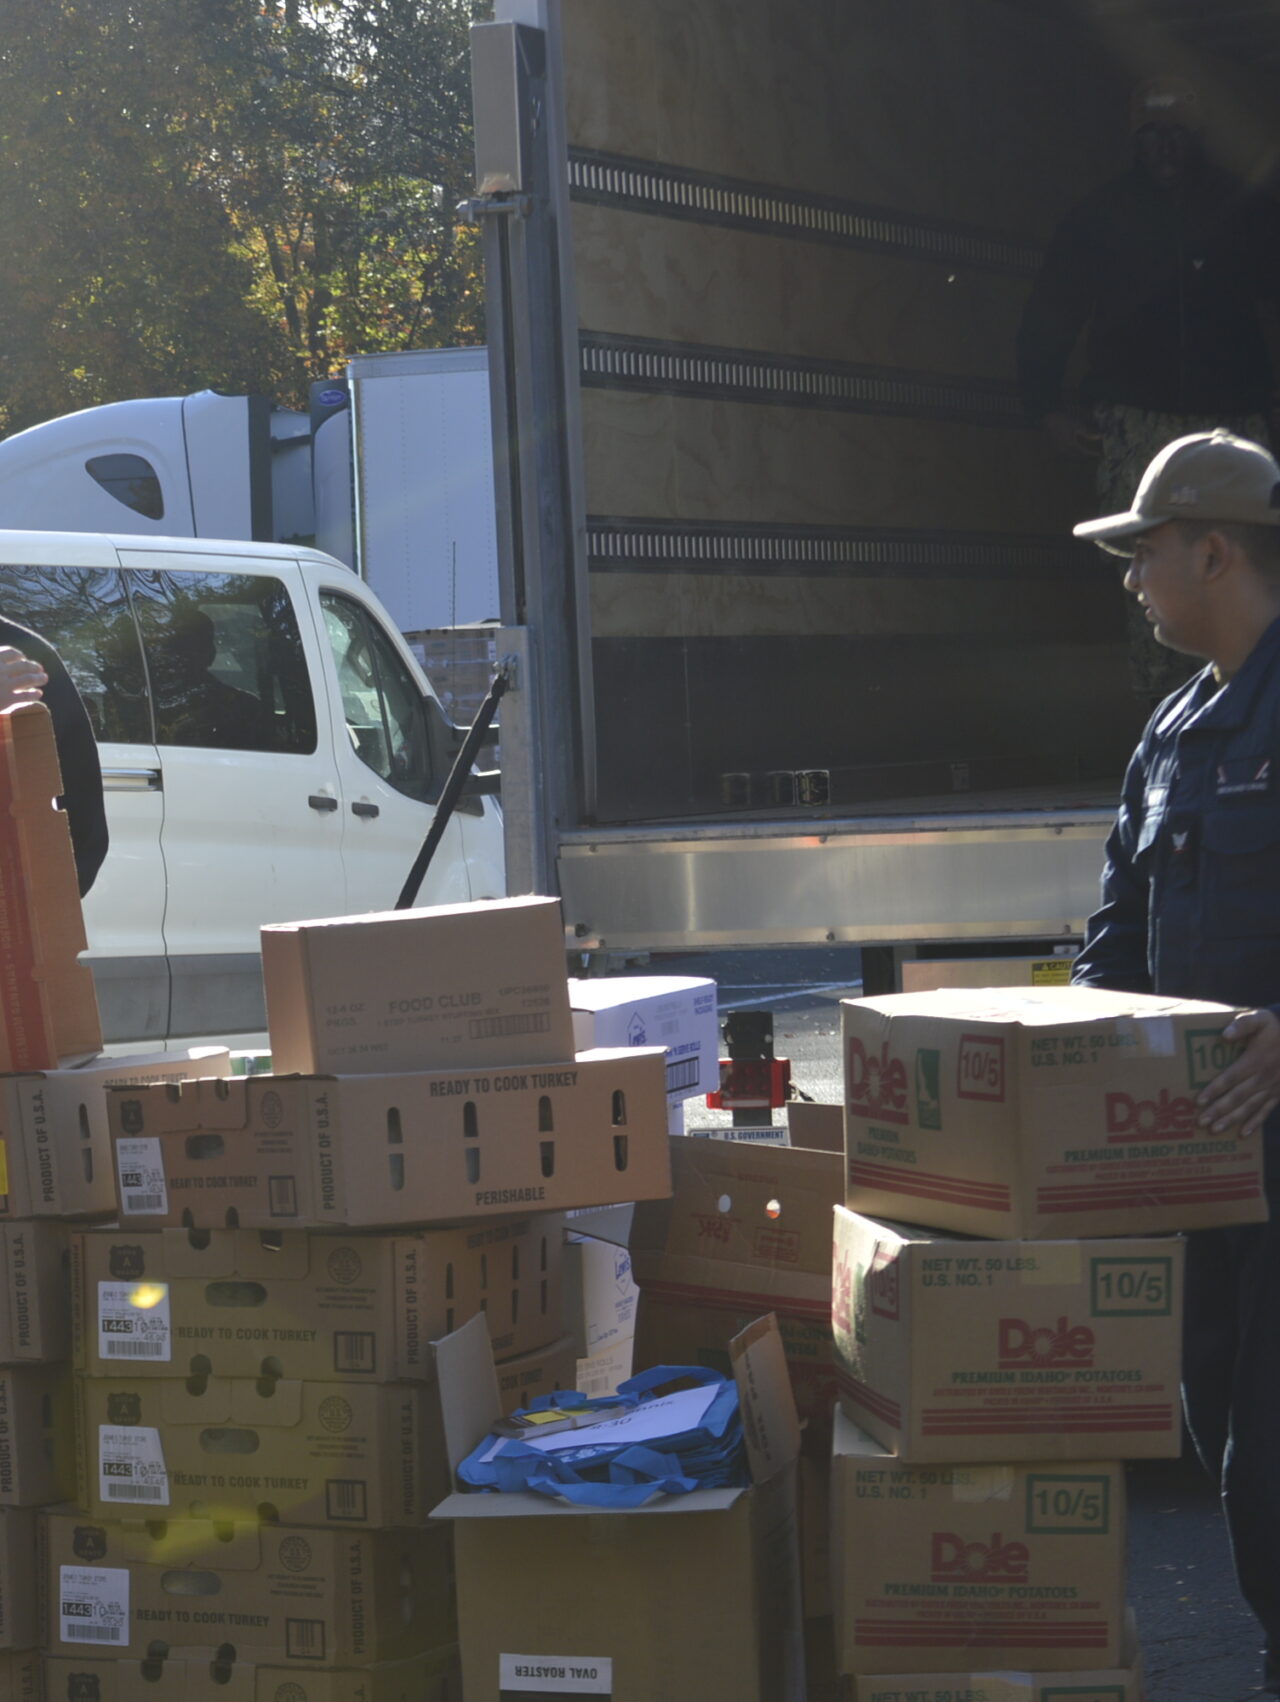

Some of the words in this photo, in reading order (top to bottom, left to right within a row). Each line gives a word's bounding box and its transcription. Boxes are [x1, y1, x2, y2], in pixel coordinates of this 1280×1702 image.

[388, 995, 433, 1015] FOOD
[439, 992, 482, 1009] CLUB
[1030, 1037, 1059, 1052] NET
[1062, 1036, 1087, 1051] WT.
[1089, 1035, 1106, 1049] 50
[1032, 1053, 1059, 1068] U.S.
[1062, 1051, 1088, 1066] NO.
[1091, 1050, 1099, 1064] 1
[849, 1036, 908, 1110] Dole
[962, 1050, 999, 1088] 10/5
[429, 1078, 472, 1097] READY
[473, 1077, 491, 1094] TO
[493, 1074, 529, 1092] COOK
[531, 1070, 579, 1090] TURKEY
[315, 1091, 331, 1130] U.S.A.
[1104, 1088, 1196, 1135] Dole
[35, 1128, 49, 1144] OF
[319, 1131, 333, 1149] OF
[724, 1131, 737, 1140] U.S.
[738, 1130, 785, 1140] GOVERNMENT
[1064, 1150, 1125, 1163] PREMIUM
[1177, 1140, 1238, 1156] POTATOES
[37, 1146, 56, 1203] PRODUCT
[206, 1176, 228, 1188] COOK
[229, 1175, 258, 1188] TURKEY
[318, 1151, 336, 1211] PRODUCT
[475, 1186, 546, 1206] PERISHABLE
[922, 1258, 953, 1271] NET
[955, 1258, 982, 1271] WT.
[985, 1258, 1002, 1271] 50
[1006, 1258, 1040, 1271] LBS.
[15, 1271, 28, 1288] OF
[922, 1274, 951, 1287] U.S.
[955, 1274, 982, 1287] NO.
[986, 1274, 994, 1287] 1
[1099, 1271, 1163, 1303] 10/5
[404, 1286, 418, 1304] OF
[18, 1290, 31, 1347] PRODUCT
[102, 1320, 132, 1333] 1443
[178, 1326, 215, 1339] READY
[219, 1327, 232, 1339] TO
[236, 1327, 269, 1340] COOK
[272, 1328, 318, 1342] TURKEY
[404, 1306, 420, 1366] PRODUCT
[998, 1316, 1096, 1367] Dole
[951, 1370, 1016, 1384] PREMIUM
[1075, 1369, 1143, 1383] POTATOES
[103, 1462, 132, 1476] 1443
[856, 1470, 887, 1483] NET
[890, 1471, 917, 1485] WT.
[919, 1472, 938, 1485] 50
[173, 1474, 208, 1488] READY
[212, 1475, 226, 1489] TO
[228, 1475, 262, 1489] COOK
[264, 1477, 309, 1491] TURKEY
[856, 1486, 885, 1500] U.S.
[888, 1486, 916, 1500] NO.
[920, 1487, 928, 1500] 1
[1034, 1488, 1101, 1522] 10/5
[930, 1531, 1030, 1578] Dole
[350, 1577, 364, 1595] OF
[884, 1583, 949, 1598] PREMIUM
[1008, 1585, 1078, 1600] POTATOES
[62, 1603, 91, 1617] 1443
[136, 1608, 172, 1622] READY
[175, 1610, 190, 1623] TO
[193, 1610, 225, 1625] COOK
[227, 1612, 270, 1628] TURKEY
[351, 1598, 366, 1655] PRODUCT
[514, 1665, 567, 1679] ROASTER
[570, 1666, 599, 1680] OVAL
[871, 1691, 903, 1702] NET
[934, 1690, 951, 1702] 50
